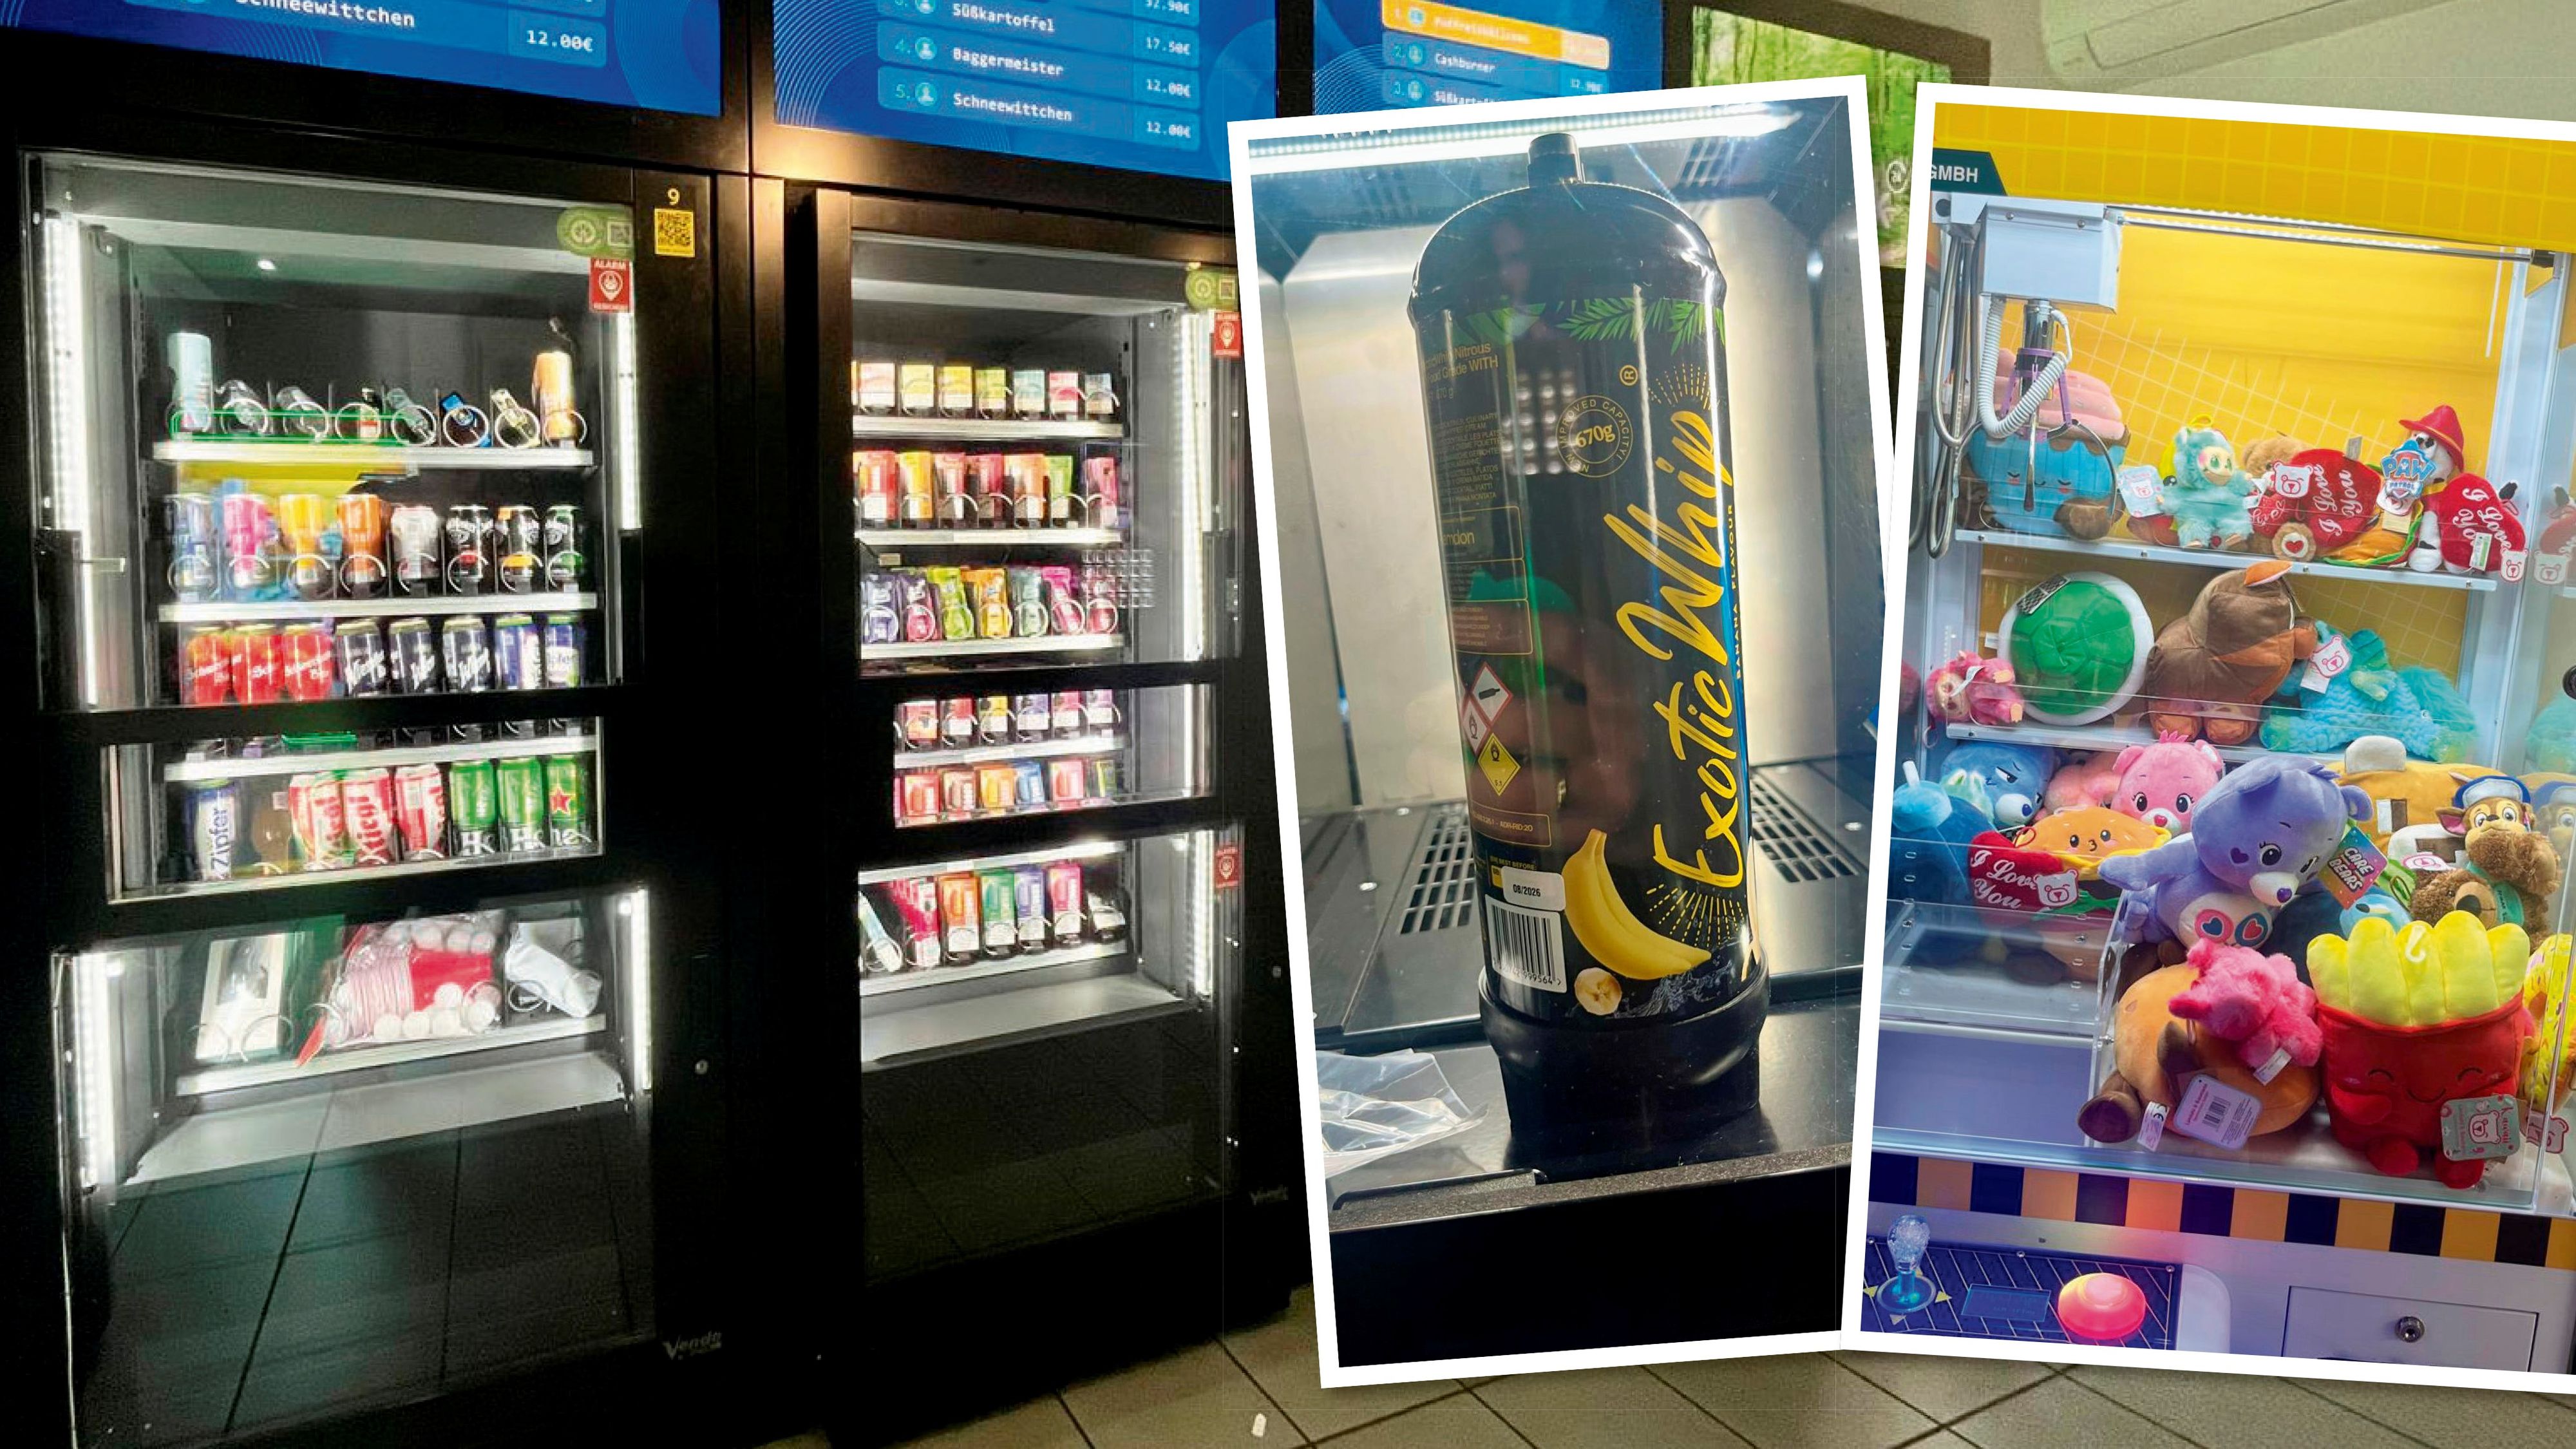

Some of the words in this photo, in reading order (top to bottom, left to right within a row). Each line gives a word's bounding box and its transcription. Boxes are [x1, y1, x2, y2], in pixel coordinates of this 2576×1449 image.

[527, 30, 593, 53] 12.00€
[1146, 37, 1191, 55] 17.50€
[952, 47, 1064, 76] Baggermeister
[1146, 79, 1191, 97] 12.00€
[952, 92, 1072, 122] Schneewittchen
[1146, 121, 1191, 138] 12.00€
[667, 188, 680, 205] 9
[1454, 343, 1492, 360] Nitrous
[1468, 354, 1499, 372] WITH
[1575, 424, 1616, 448] 670g
[2381, 457, 2436, 482] PAW
[1727, 505, 1736, 590] FLAVOUR
[209, 808, 231, 867] Zipfer
[2344, 847, 2375, 876] CARE
[2328, 858, 2363, 890] BEARS
[1513, 884, 1541, 896] 08/2026
[1973, 878, 2022, 909] You
[1524, 971, 1553, 985] 999564
